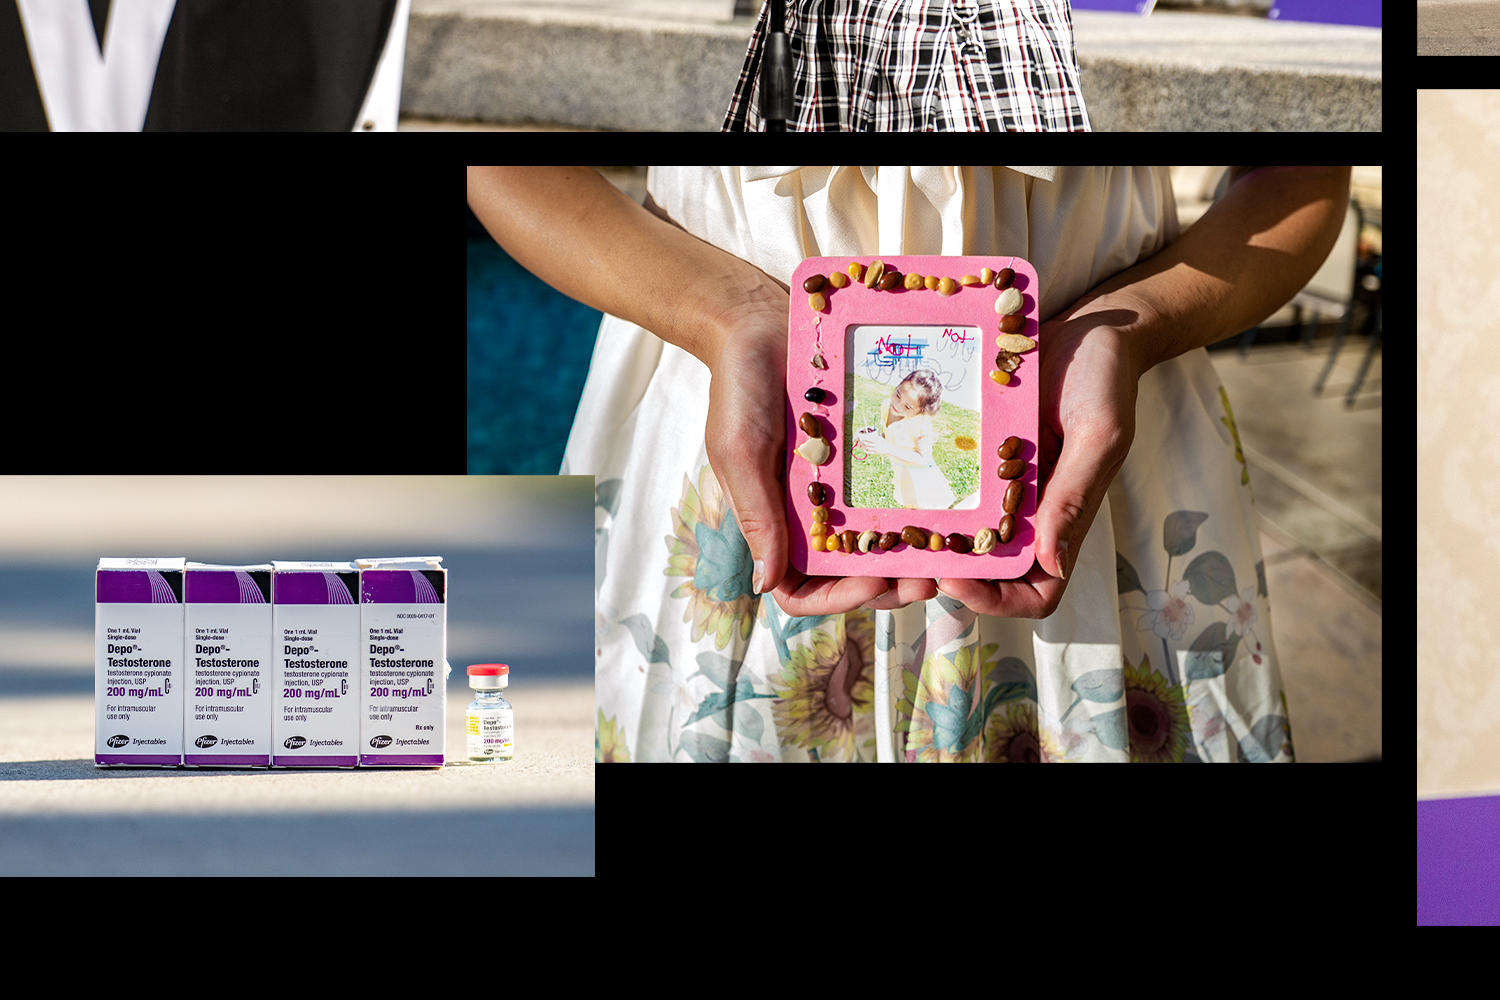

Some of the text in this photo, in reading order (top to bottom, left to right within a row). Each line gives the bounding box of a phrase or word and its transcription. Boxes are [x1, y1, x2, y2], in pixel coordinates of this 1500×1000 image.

[107, 657, 171, 667] Testosterone
[195, 658, 259, 668] Testosterone
[284, 659, 348, 669] Testosterone
[370, 658, 434, 668] Testosterone
[407, 670, 434, 678] cypionate
[195, 678, 221, 686] injection,
[284, 679, 310, 687] injection,
[370, 678, 396, 686] injection,
[107, 687, 164, 699] 200 mg/mL
[195, 687, 252, 699] 200 mg/mL
[284, 688, 340, 700] 200 mg/mL
[370, 687, 426, 699] 200 mg/mL
[118, 713, 130, 721] only
[206, 713, 218, 721] only
[295, 714, 307, 722] only
[132, 738, 167, 746] Injectables
[220, 738, 255, 746] Injectables
[309, 739, 343, 747] Injectables
[395, 738, 429, 747] Injectables
